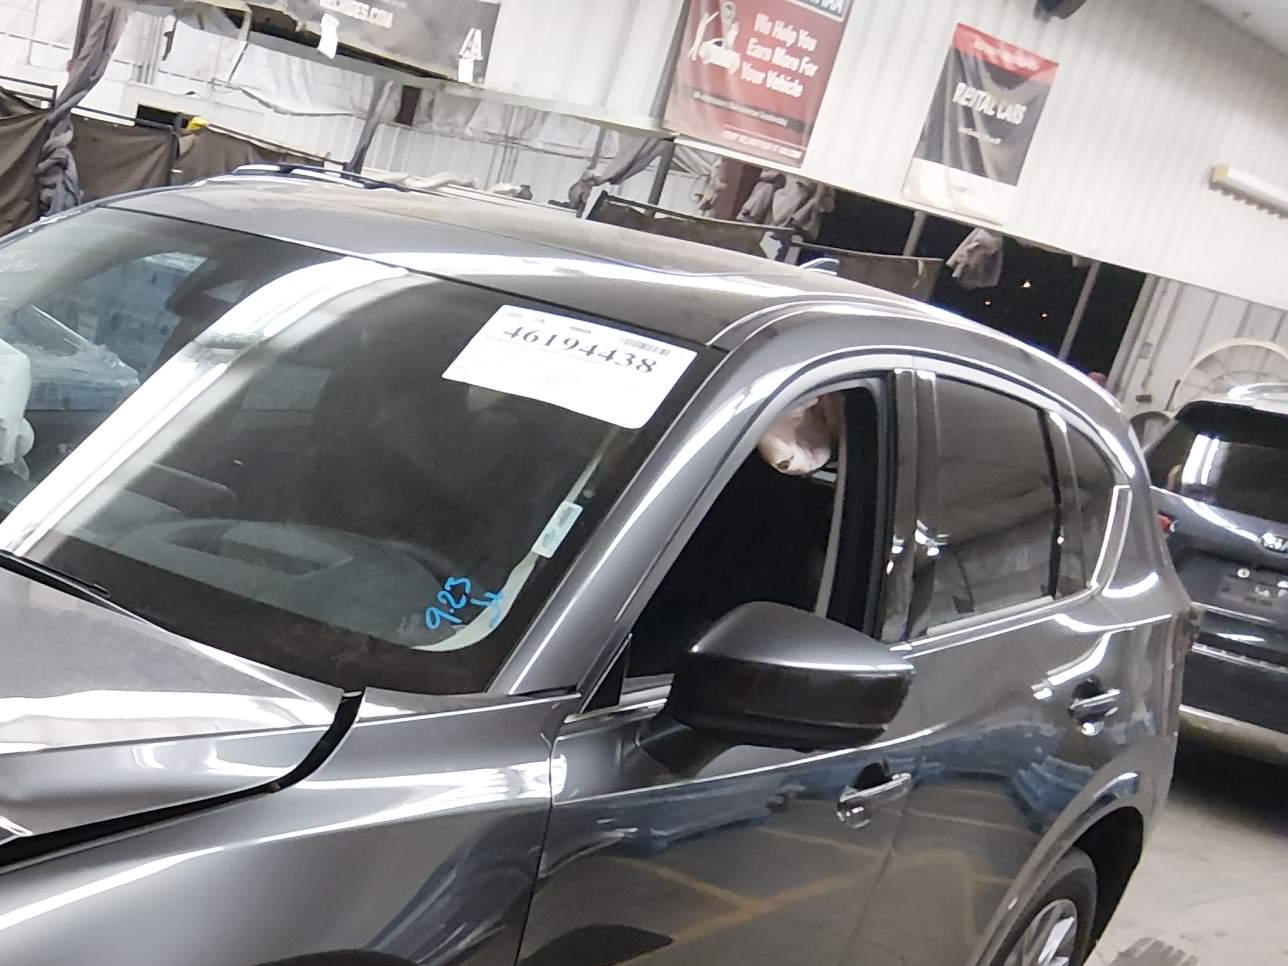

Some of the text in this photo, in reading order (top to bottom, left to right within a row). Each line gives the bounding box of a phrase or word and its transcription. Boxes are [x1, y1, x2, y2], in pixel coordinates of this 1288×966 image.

[772, 20, 798, 47] Help
[741, 61, 804, 98] Your Vehicle
[799, 56, 819, 77] For
[952, 82, 1028, 125] RENTAL CARS
[503, 326, 657, 374] 46194438
